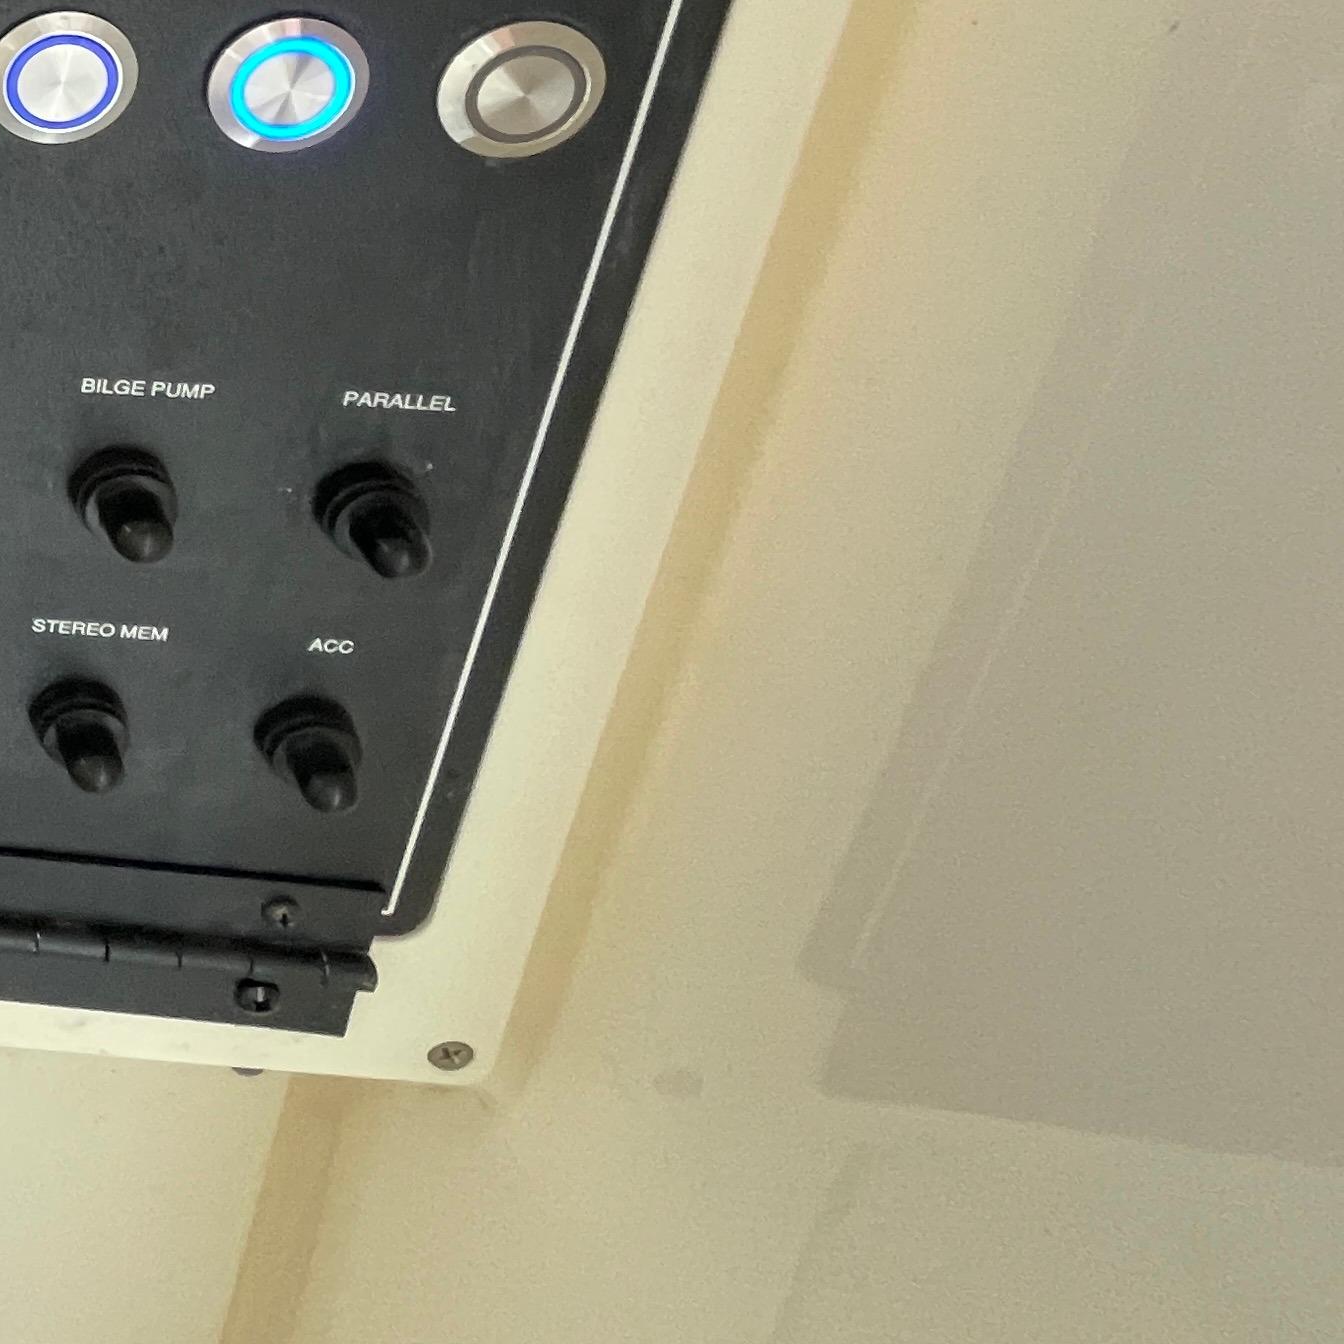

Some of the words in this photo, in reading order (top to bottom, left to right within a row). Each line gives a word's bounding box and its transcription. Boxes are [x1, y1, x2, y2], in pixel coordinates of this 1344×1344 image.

[81, 378, 146, 396] BILGE
[151, 382, 215, 398] PUMP
[343, 391, 456, 411] PARALLEL
[32, 619, 115, 637] STEREO
[120, 625, 168, 641] MEM
[308, 638, 354, 654] ACC
